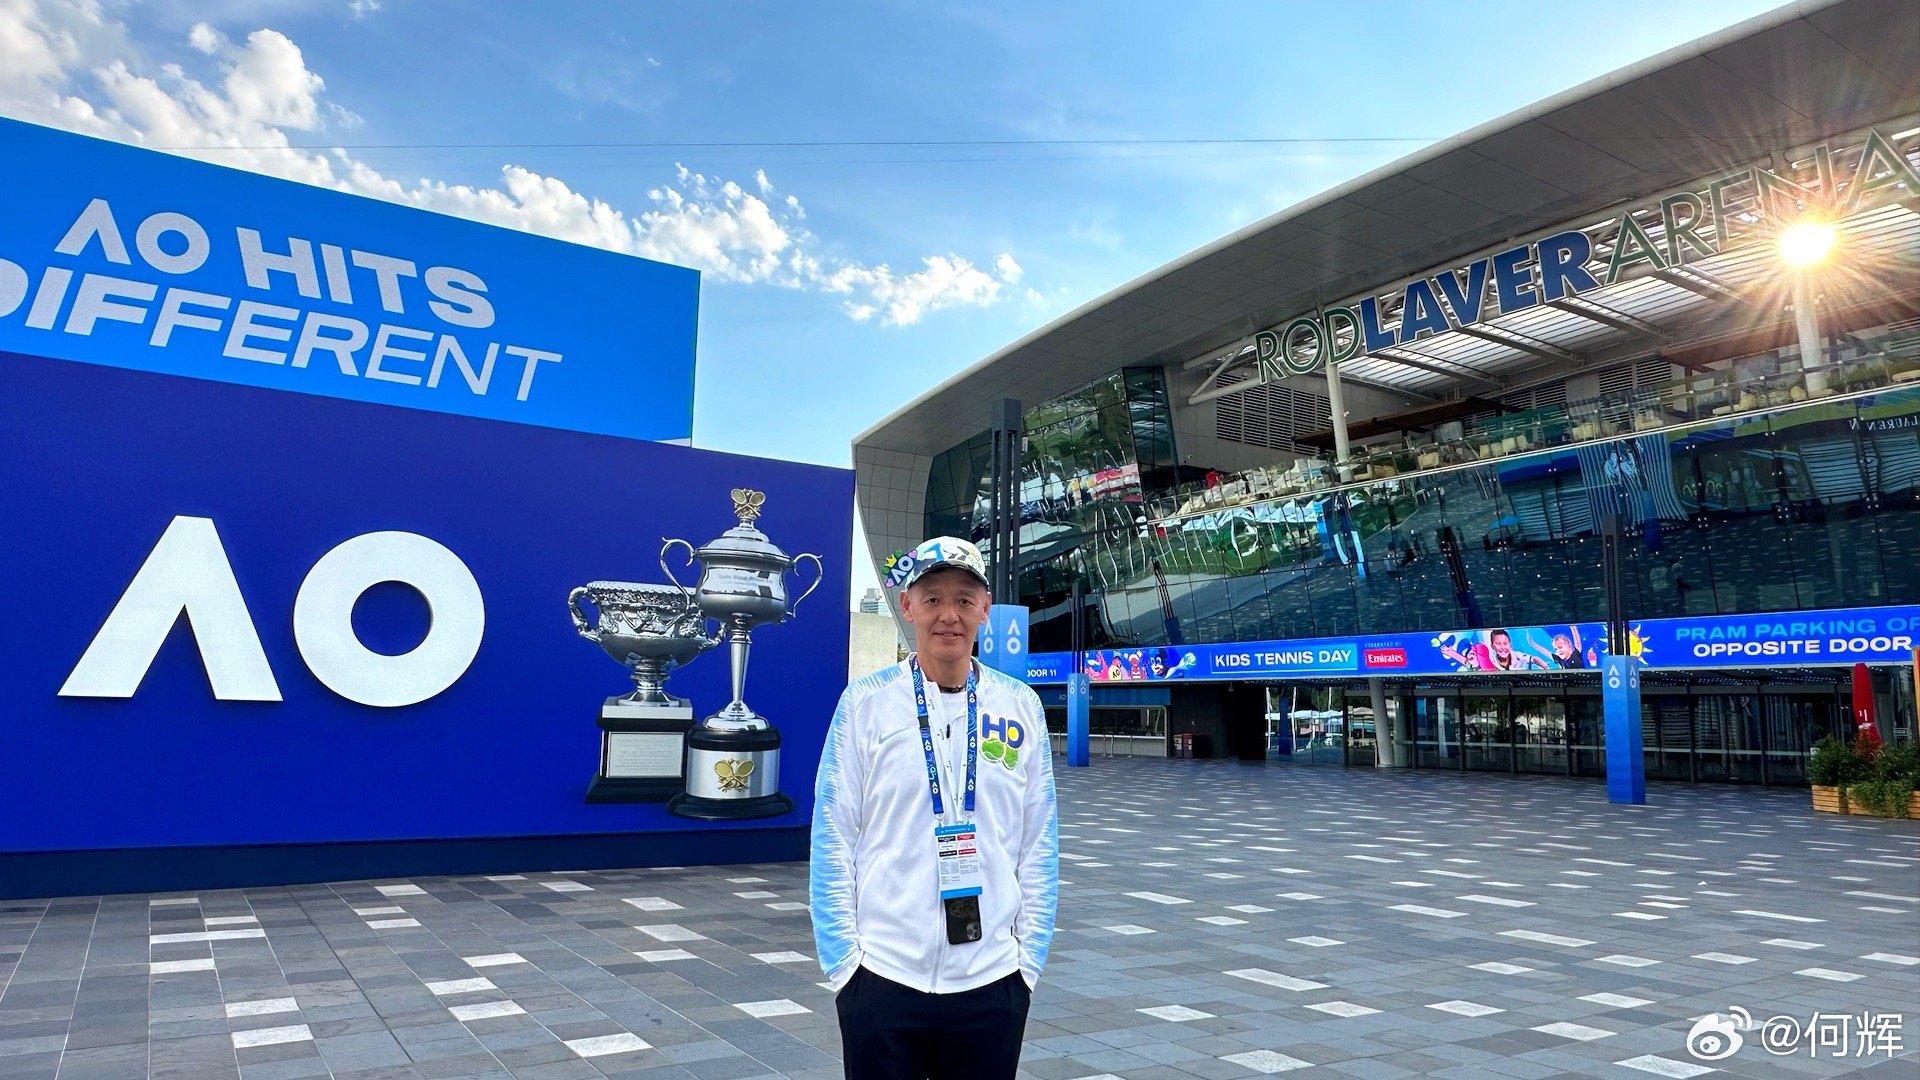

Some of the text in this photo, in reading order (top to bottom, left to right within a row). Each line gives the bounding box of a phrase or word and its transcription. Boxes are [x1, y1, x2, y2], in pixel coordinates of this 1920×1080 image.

[54, 198, 495, 329] AO HITS
[1255, 127, 1920, 384] ROD LAVER ARENA
[57, 514, 486, 708] AO
[1006, 618, 1021, 654] AO
[1676, 625, 1746, 641] PRAM
[1755, 618, 1876, 638] PARKING
[1215, 649, 1352, 667] KIDS TENNIS DAY
[1367, 653, 1404, 664] Emirates
[1693, 636, 1912, 657] OPPOSITE DOOR
[1608, 664, 1620, 689] AO
